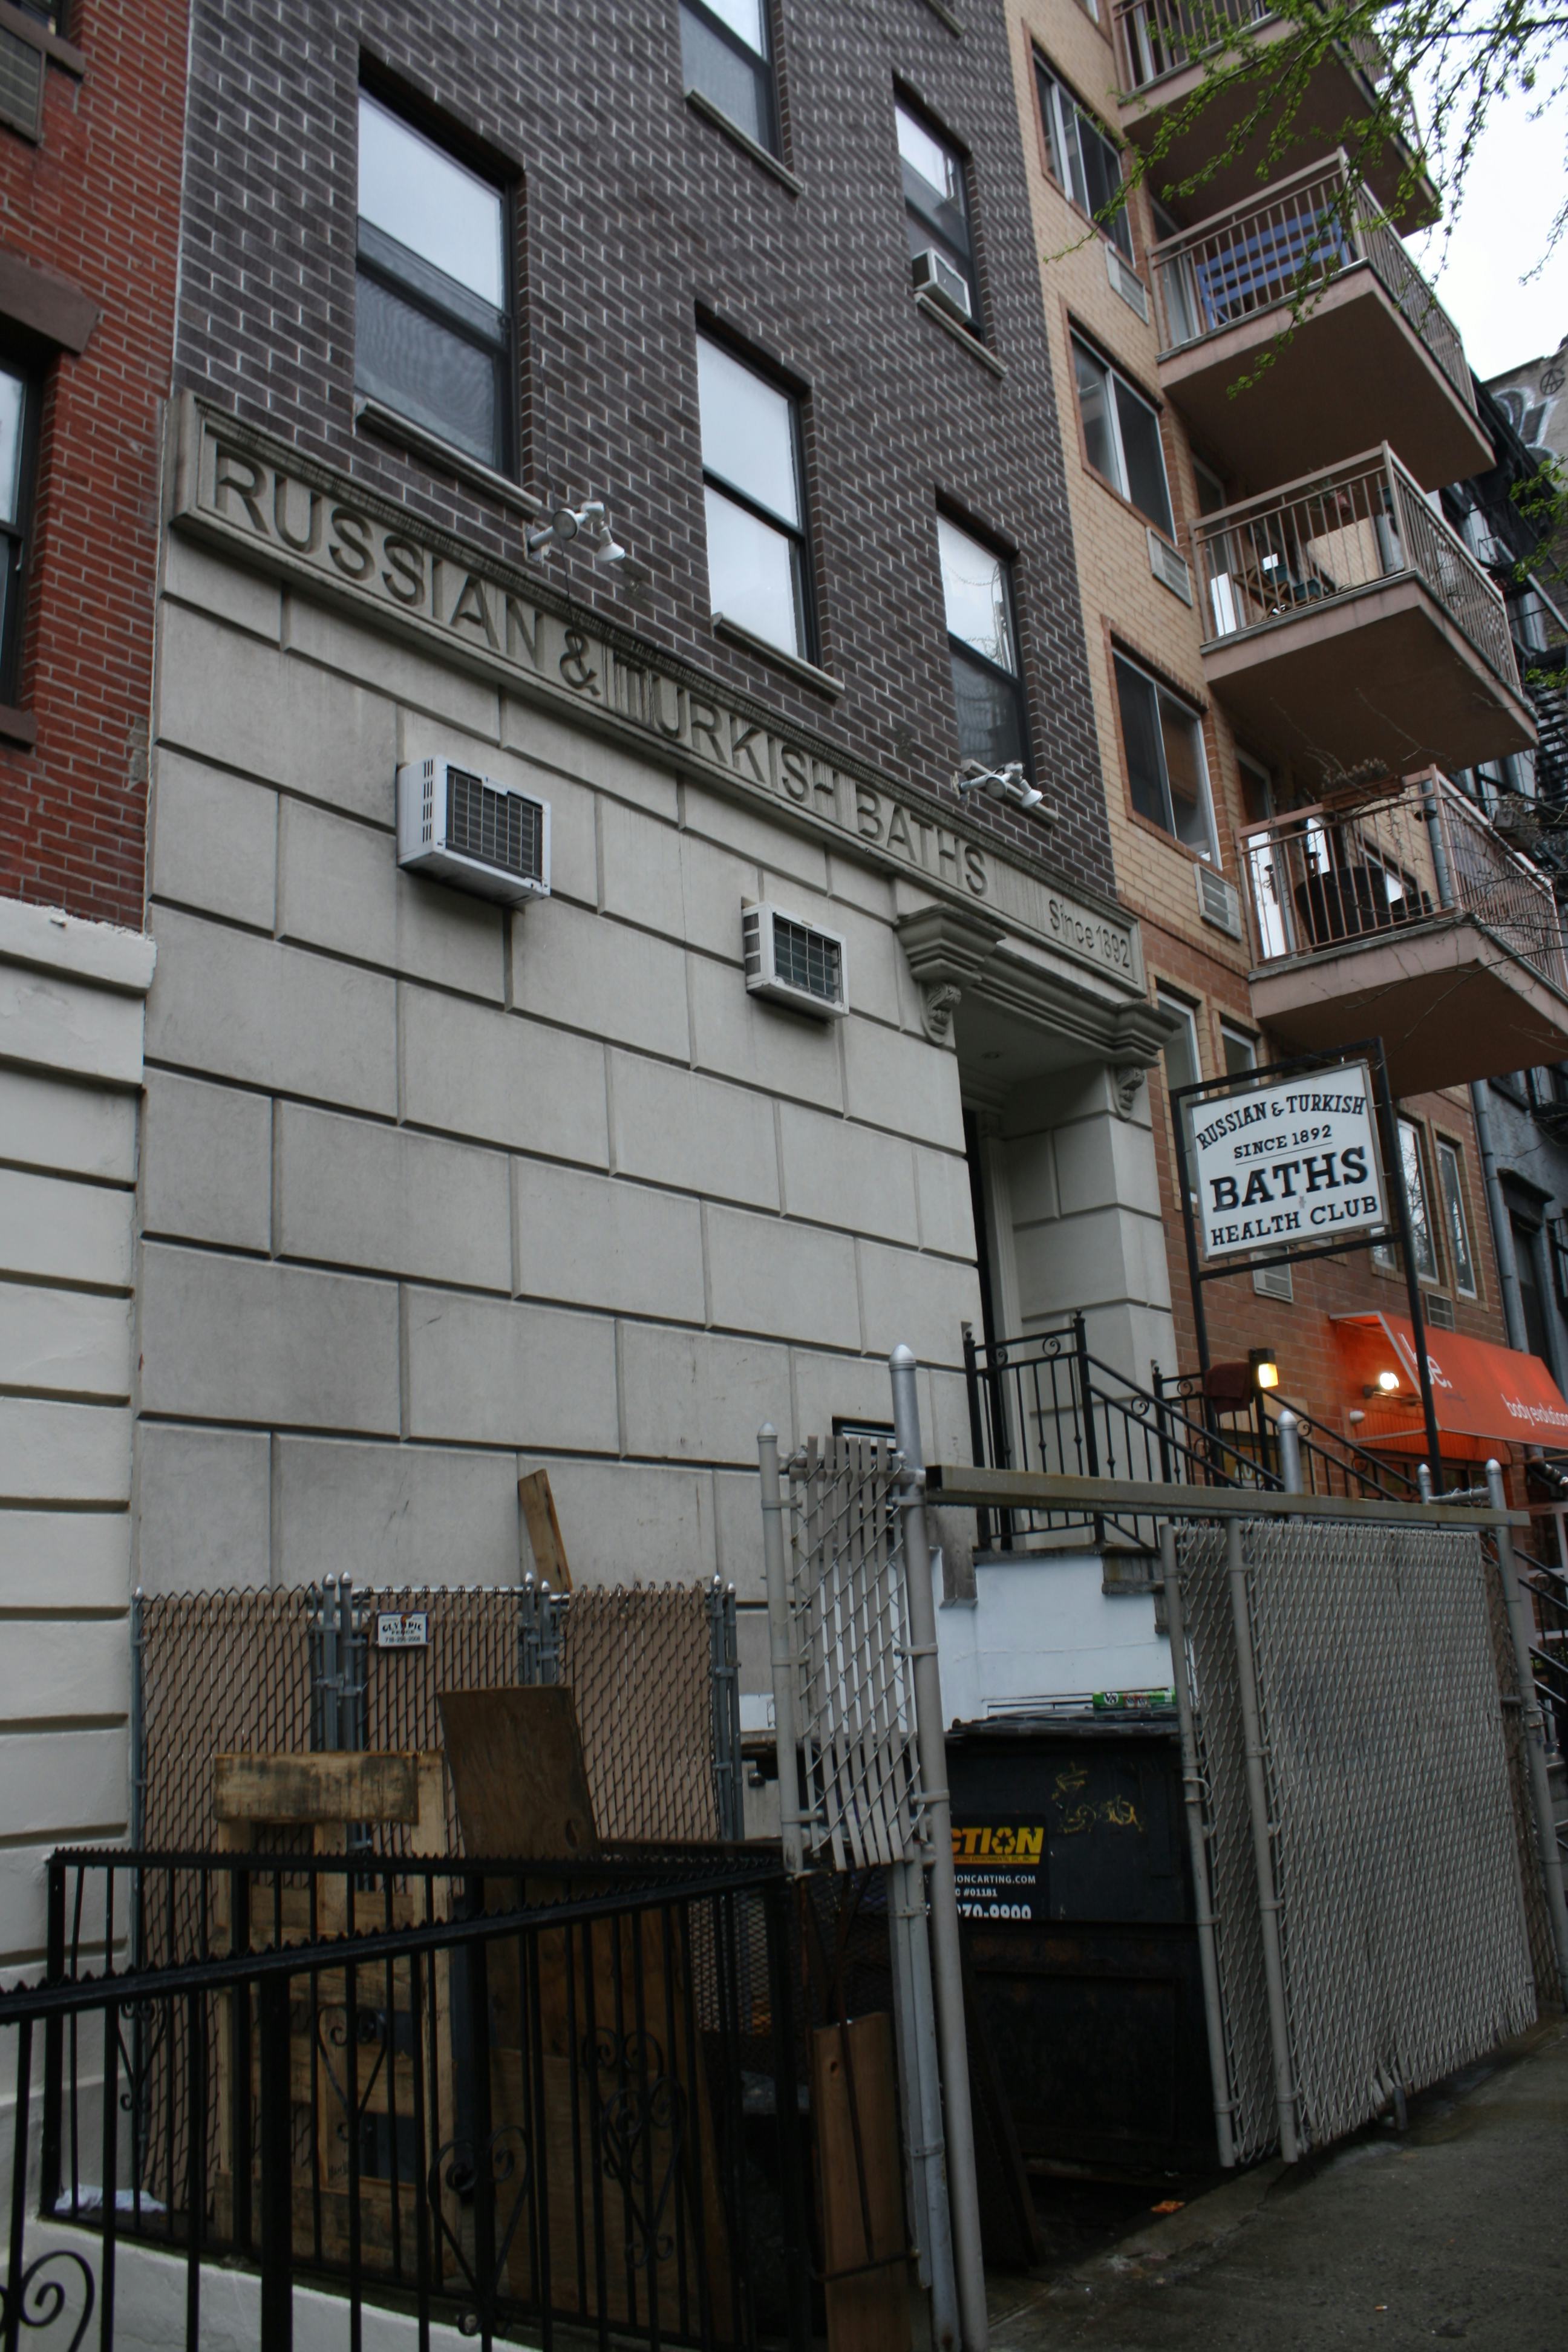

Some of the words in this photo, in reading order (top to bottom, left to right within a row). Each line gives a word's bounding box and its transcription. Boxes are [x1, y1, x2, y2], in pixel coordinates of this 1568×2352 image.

[215, 446, 545, 673] RUSSIAN
[560, 629, 601, 696] &
[613, 649, 843, 826] TURKISH
[855, 782, 988, 897] BATHS
[1048, 898, 1095, 949] Since
[1096, 924, 1131, 969] 1892
[1196, 1101, 1267, 1151] RUSSIAN
[1272, 1102, 1285, 1117] &
[1286, 1094, 1366, 1116] TURKISH
[1233, 1135, 1288, 1159] SINCE
[1292, 1124, 1332, 1146] 1892
[1209, 1146, 1368, 1212] BATHS
[1210, 1211, 1301, 1246] HEALTH
[1310, 1195, 1377, 1225] CLUB
